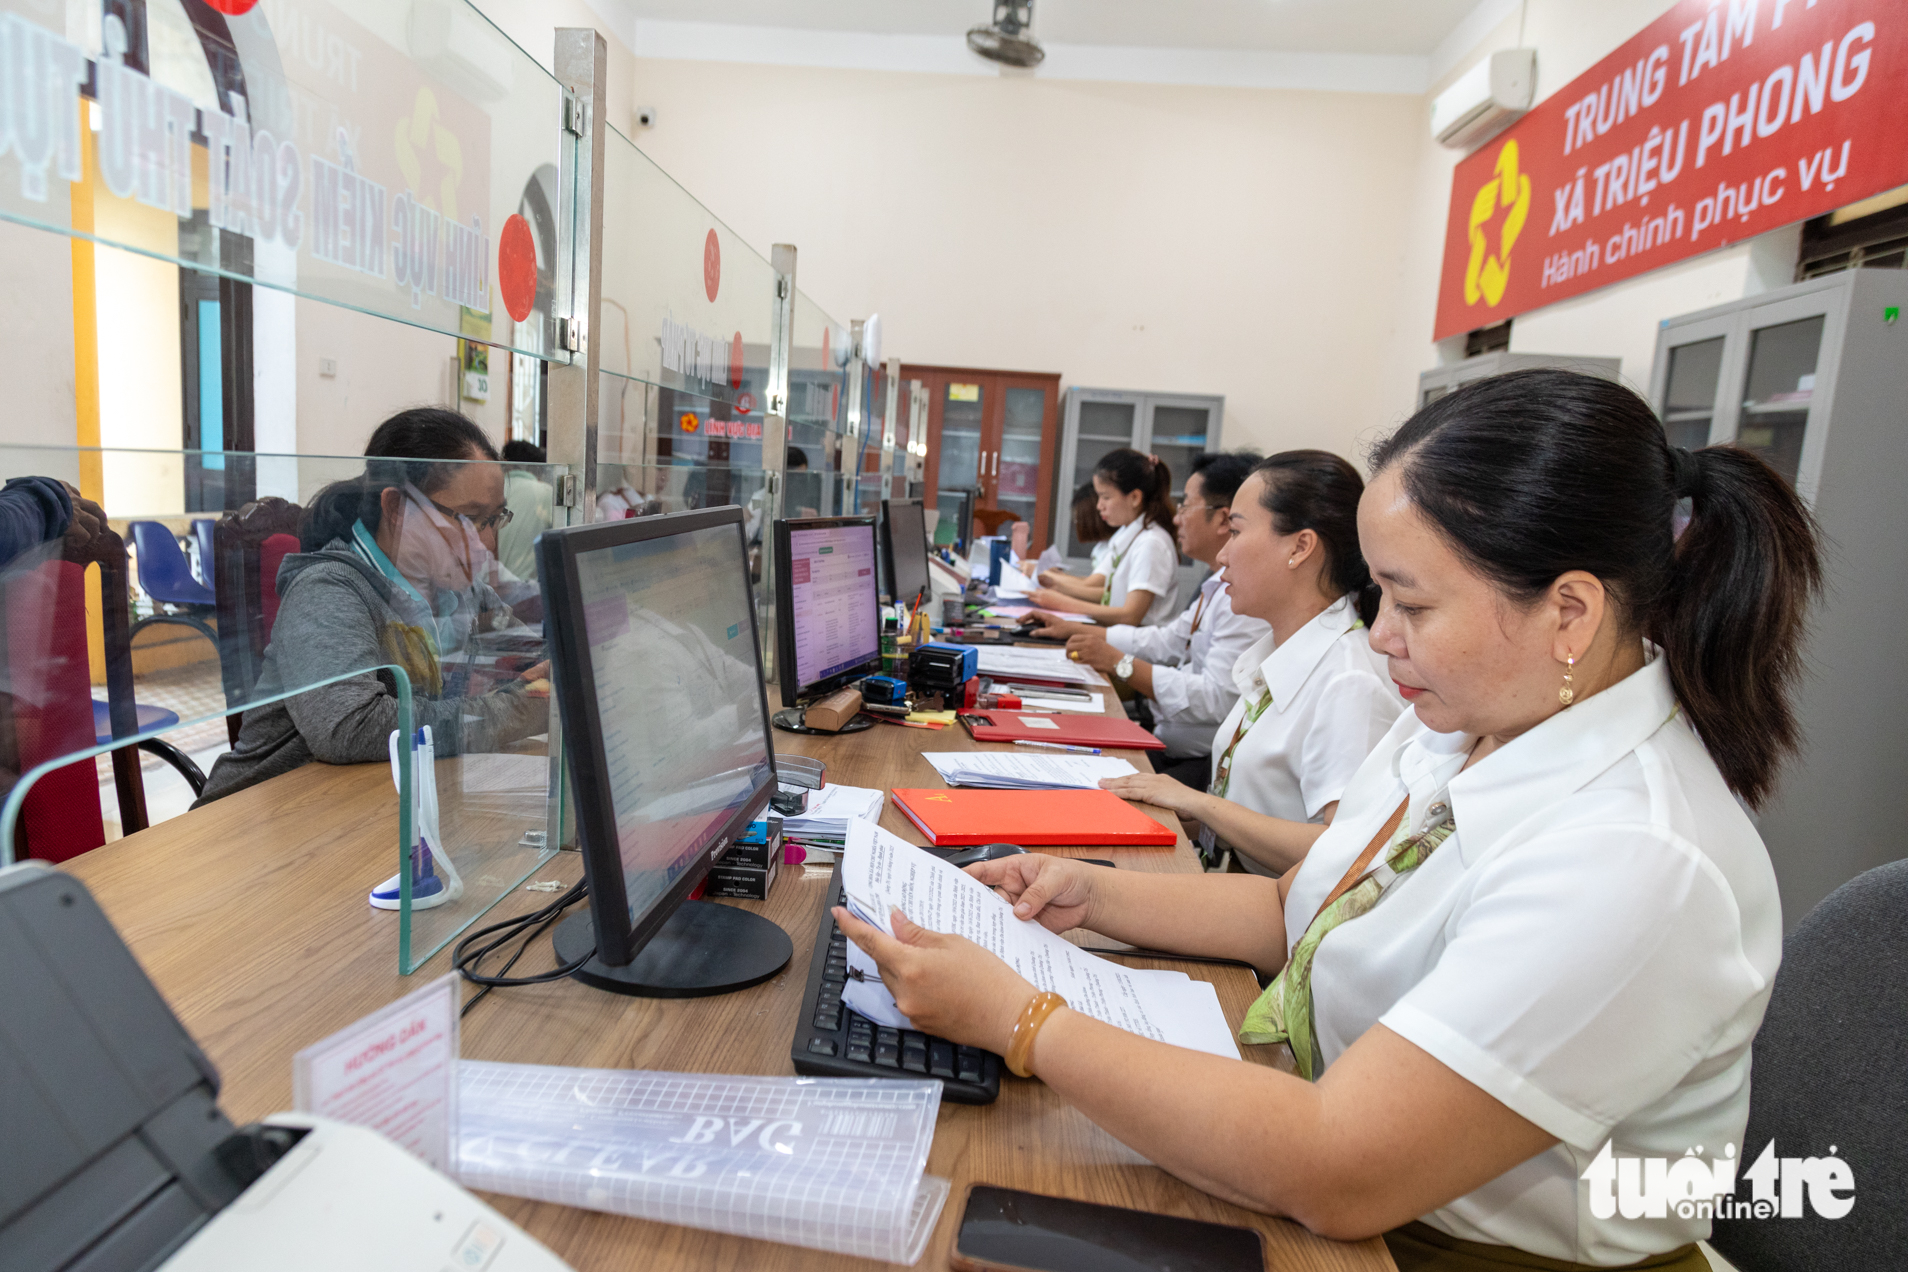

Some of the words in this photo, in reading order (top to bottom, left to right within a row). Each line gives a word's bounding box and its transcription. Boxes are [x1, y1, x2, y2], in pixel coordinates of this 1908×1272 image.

[1549, 166, 1587, 237] XÃ
[1593, 119, 1690, 207] TRIỆU
[1696, 20, 1876, 169] PHONG
[1563, 44, 1670, 156] TRUNG
[1678, 0, 1759, 88] TÂM
[1541, 242, 1599, 289] Hành
[1605, 203, 1683, 265] chính
[1691, 167, 1787, 242] phục
[1798, 139, 1853, 194] vụ
